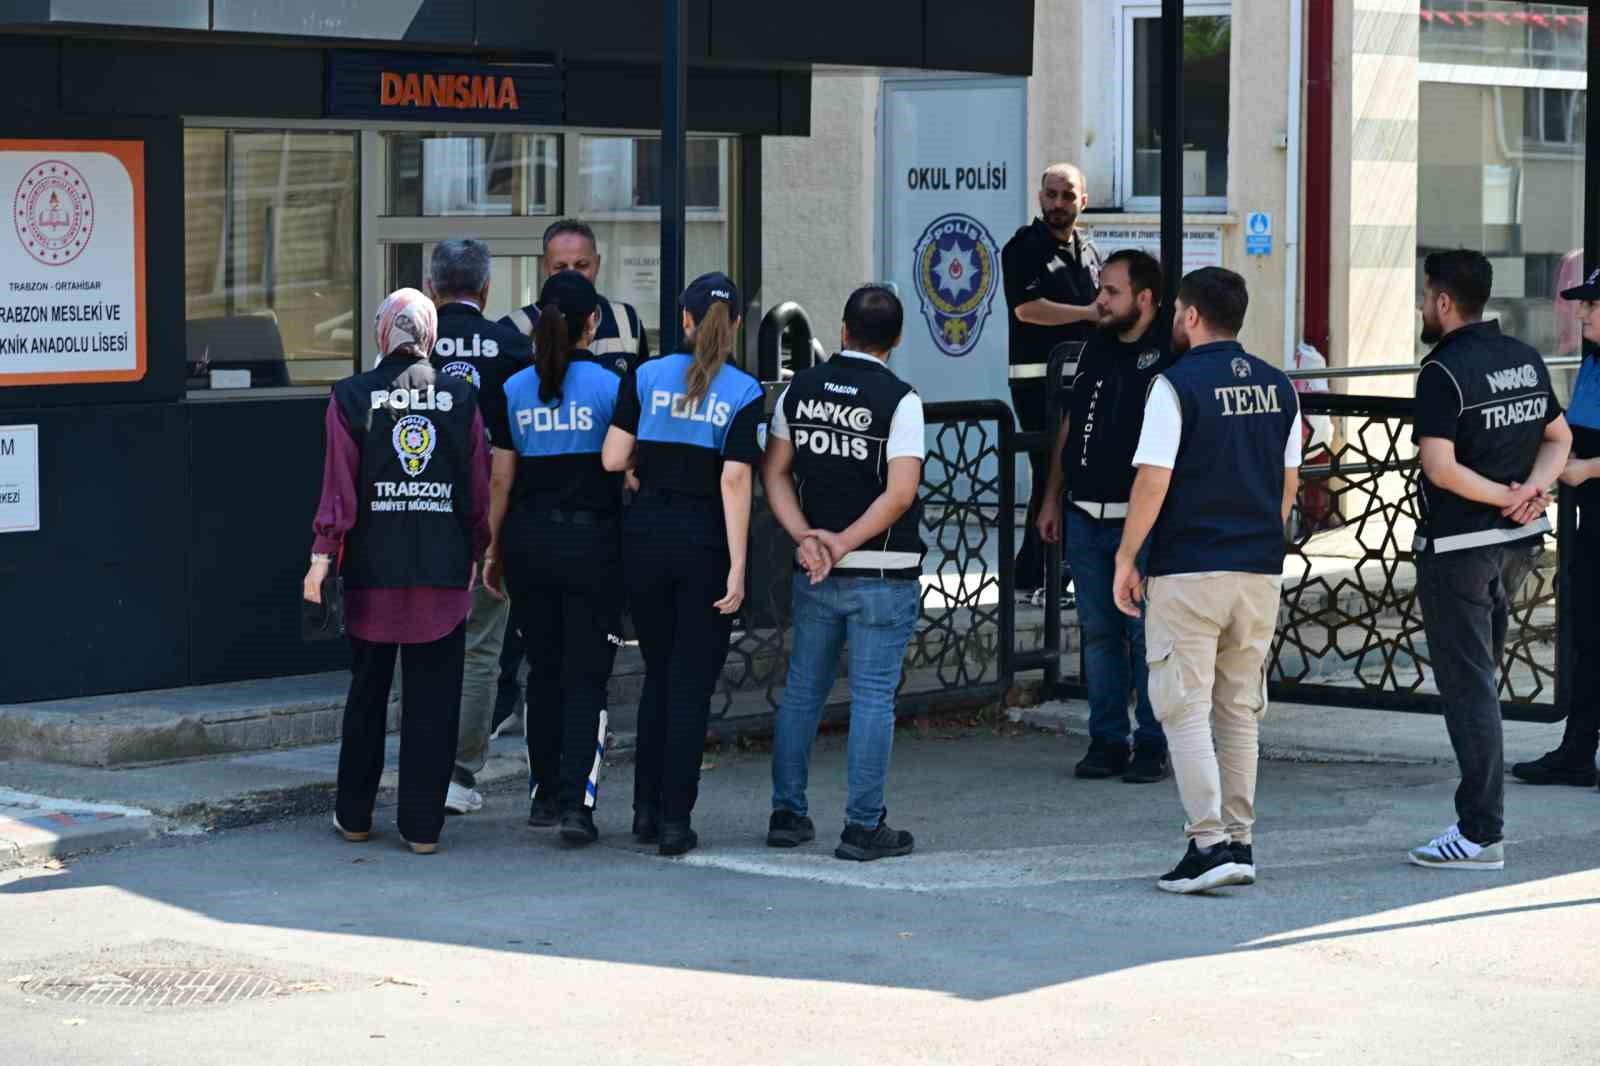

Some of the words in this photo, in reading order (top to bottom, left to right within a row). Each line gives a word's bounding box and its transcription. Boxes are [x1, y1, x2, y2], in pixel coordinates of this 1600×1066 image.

[907, 167, 950, 190] OKUL
[955, 162, 1006, 190] POLİSİ
[934, 221, 979, 241] POLİS
[9, 282, 48, 291] TRABZON
[55, 280, 101, 290] ORTAHİSAR
[0, 306, 47, 323] RABZON
[51, 301, 102, 321] MESLEKİ
[106, 304, 121, 320] VE
[0, 333, 27, 354] KNİK
[31, 336, 88, 353] ANADOLU
[92, 331, 127, 352] LİSESİ
[435, 333, 499, 358] OLİS
[370, 385, 454, 411] POLİS
[651, 390, 730, 427] POLİS
[1214, 384, 1281, 416] TEM
[516, 401, 593, 434] POLİS
[794, 429, 868, 460] POLİS
[373, 481, 453, 498] TRABZON
